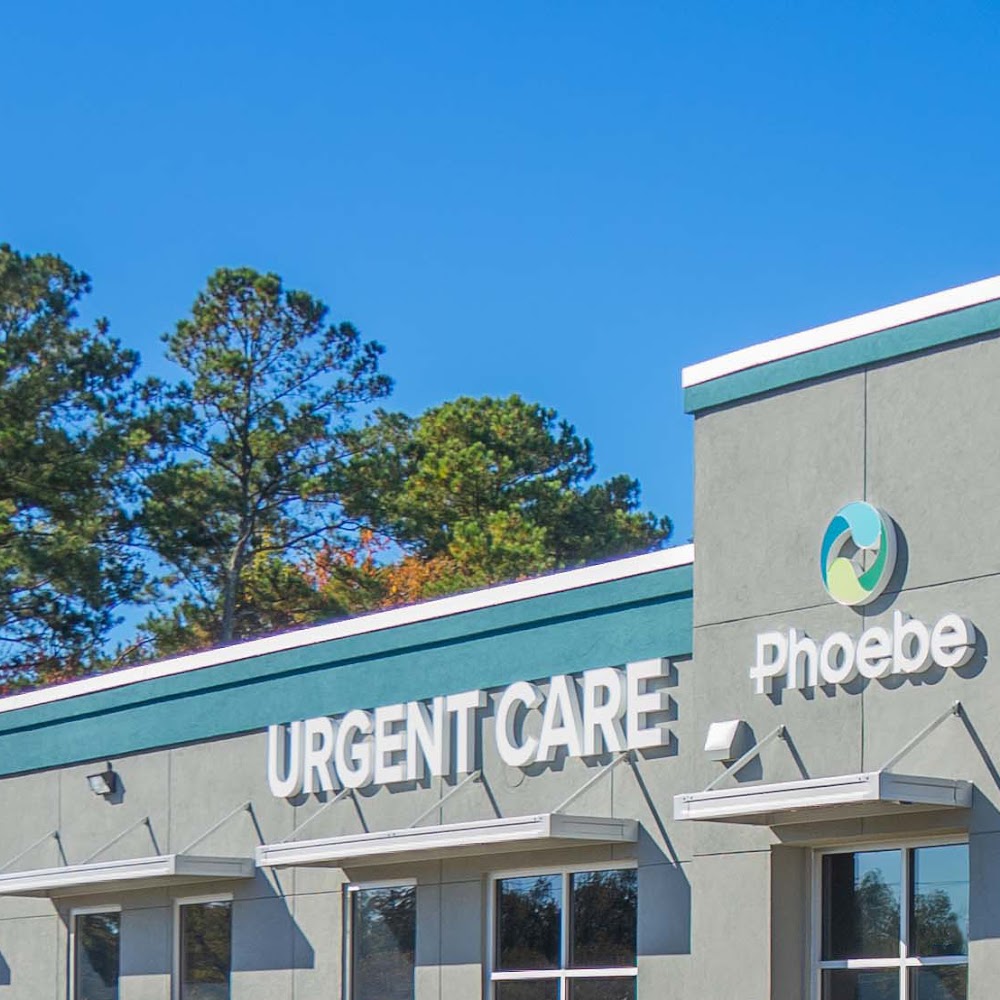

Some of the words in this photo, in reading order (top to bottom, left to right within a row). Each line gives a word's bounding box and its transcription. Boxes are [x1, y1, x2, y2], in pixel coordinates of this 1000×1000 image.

[749, 609, 977, 694] Phoebe
[266, 690, 487, 798] URGENT
[495, 658, 672, 766] CARE
